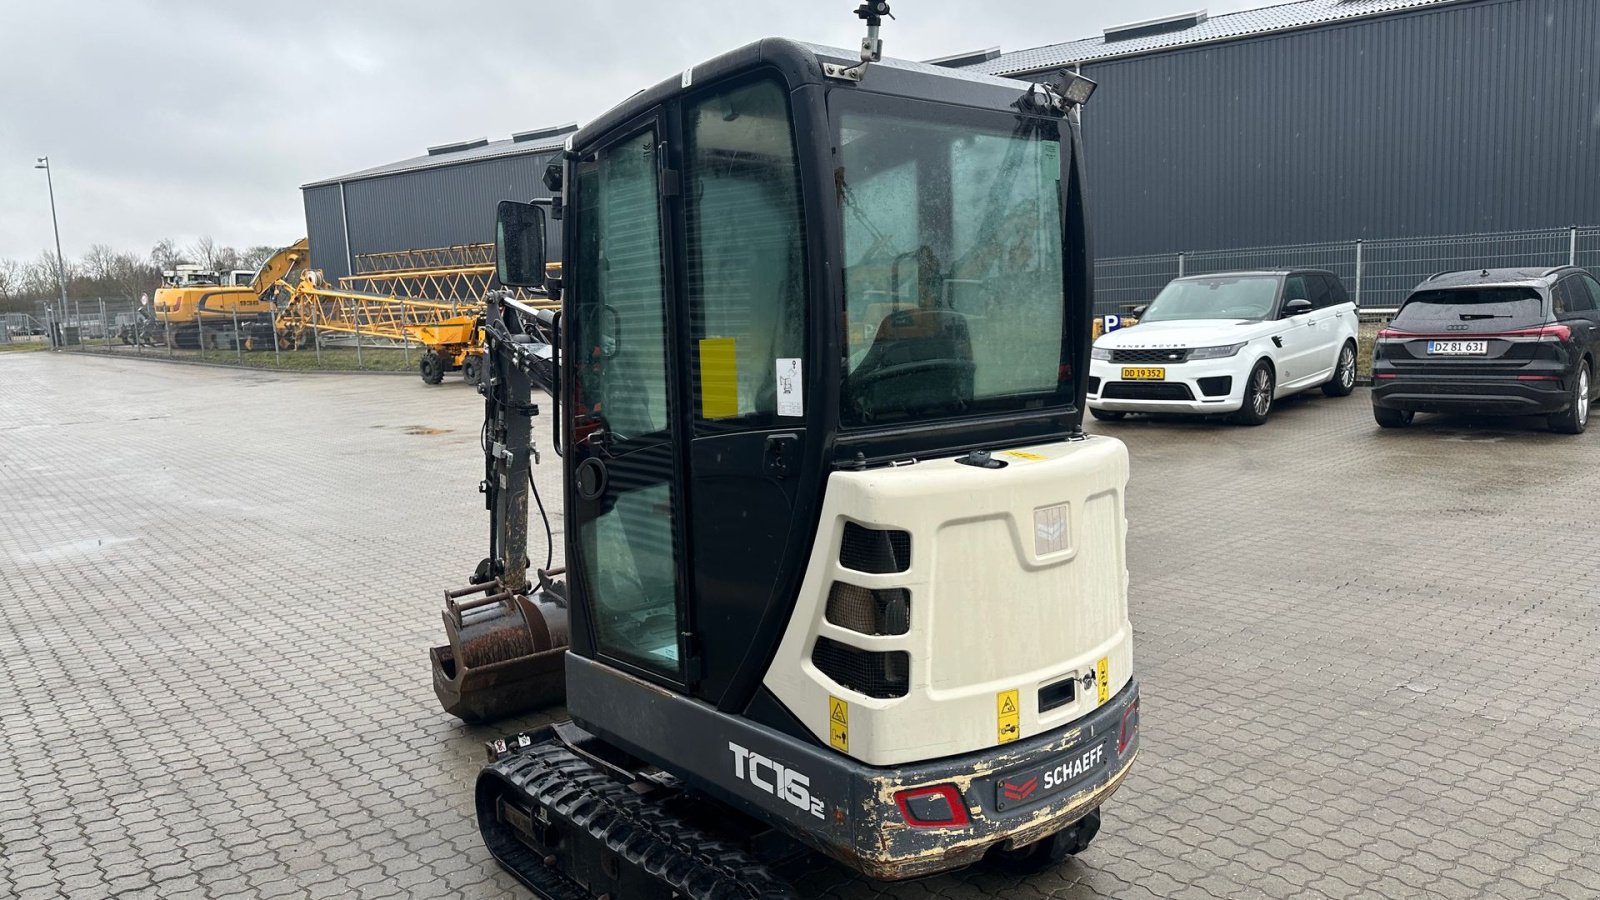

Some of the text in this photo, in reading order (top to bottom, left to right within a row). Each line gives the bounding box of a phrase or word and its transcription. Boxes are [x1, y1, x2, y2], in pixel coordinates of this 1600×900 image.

[1104, 315, 1119, 333] P
[1435, 342, 1484, 351] DZ 81 631
[1124, 369, 1162, 377] DD 19 352
[1043, 743, 1104, 789] SCHAEFF
